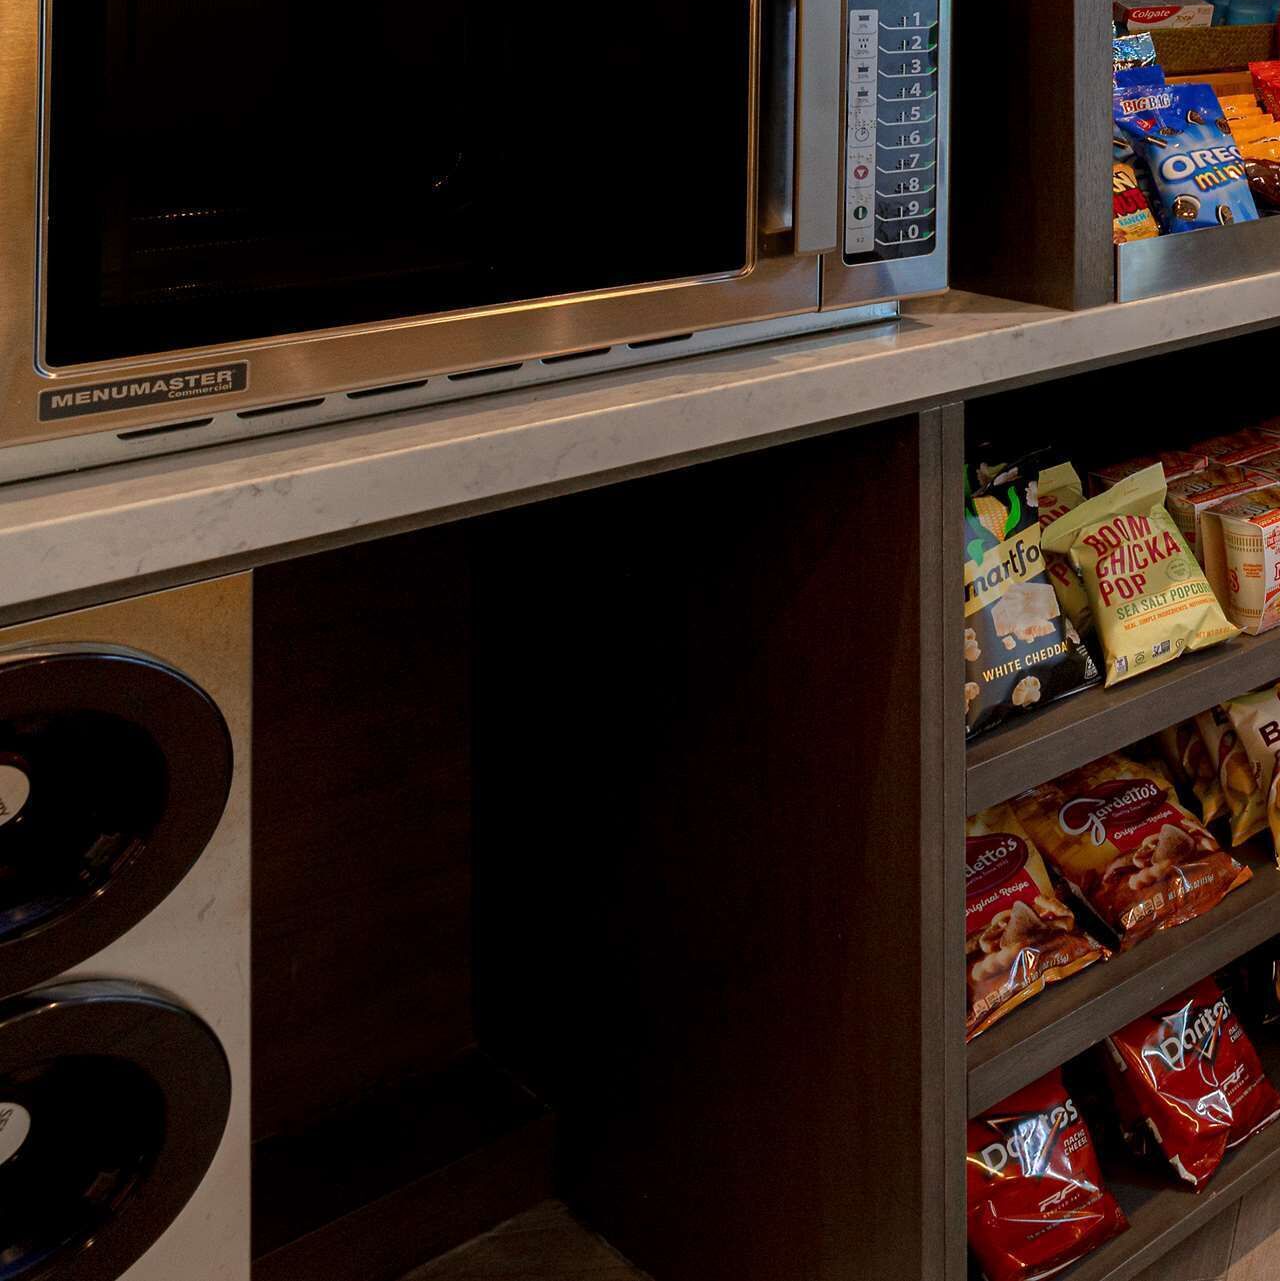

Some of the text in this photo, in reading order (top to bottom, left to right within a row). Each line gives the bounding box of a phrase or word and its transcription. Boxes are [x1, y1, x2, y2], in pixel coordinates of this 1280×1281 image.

[913, 12, 920, 26] 1
[1131, 9, 1170, 20] Colgate
[911, 36, 921, 49] 2
[911, 59, 921, 73] 3
[910, 83, 921, 96] 4
[1121, 94, 1170, 114] BIG BAG
[910, 106, 920, 120] 5
[910, 130, 920, 144] 6
[909, 154, 920, 168] 7
[909, 177, 919, 192] 8
[908, 201, 919, 215] 9
[908, 224, 919, 239] 0
[51, 370, 233, 409] MENUMASTER
[168, 383, 232, 399] Commercial
[1083, 514, 1151, 557] BOOM
[1095, 531, 1182, 579] CHICKA
[965, 540, 1041, 602] martfo
[1100, 572, 1147, 607] POP
[1117, 582, 1210, 621] SEA SALT POPCOR
[983, 656, 1021, 682] WHITE
[1059, 780, 1158, 846] Gardetto's
[966, 837, 1018, 878] detto's
[1001, 880, 1029, 897] Recipe
